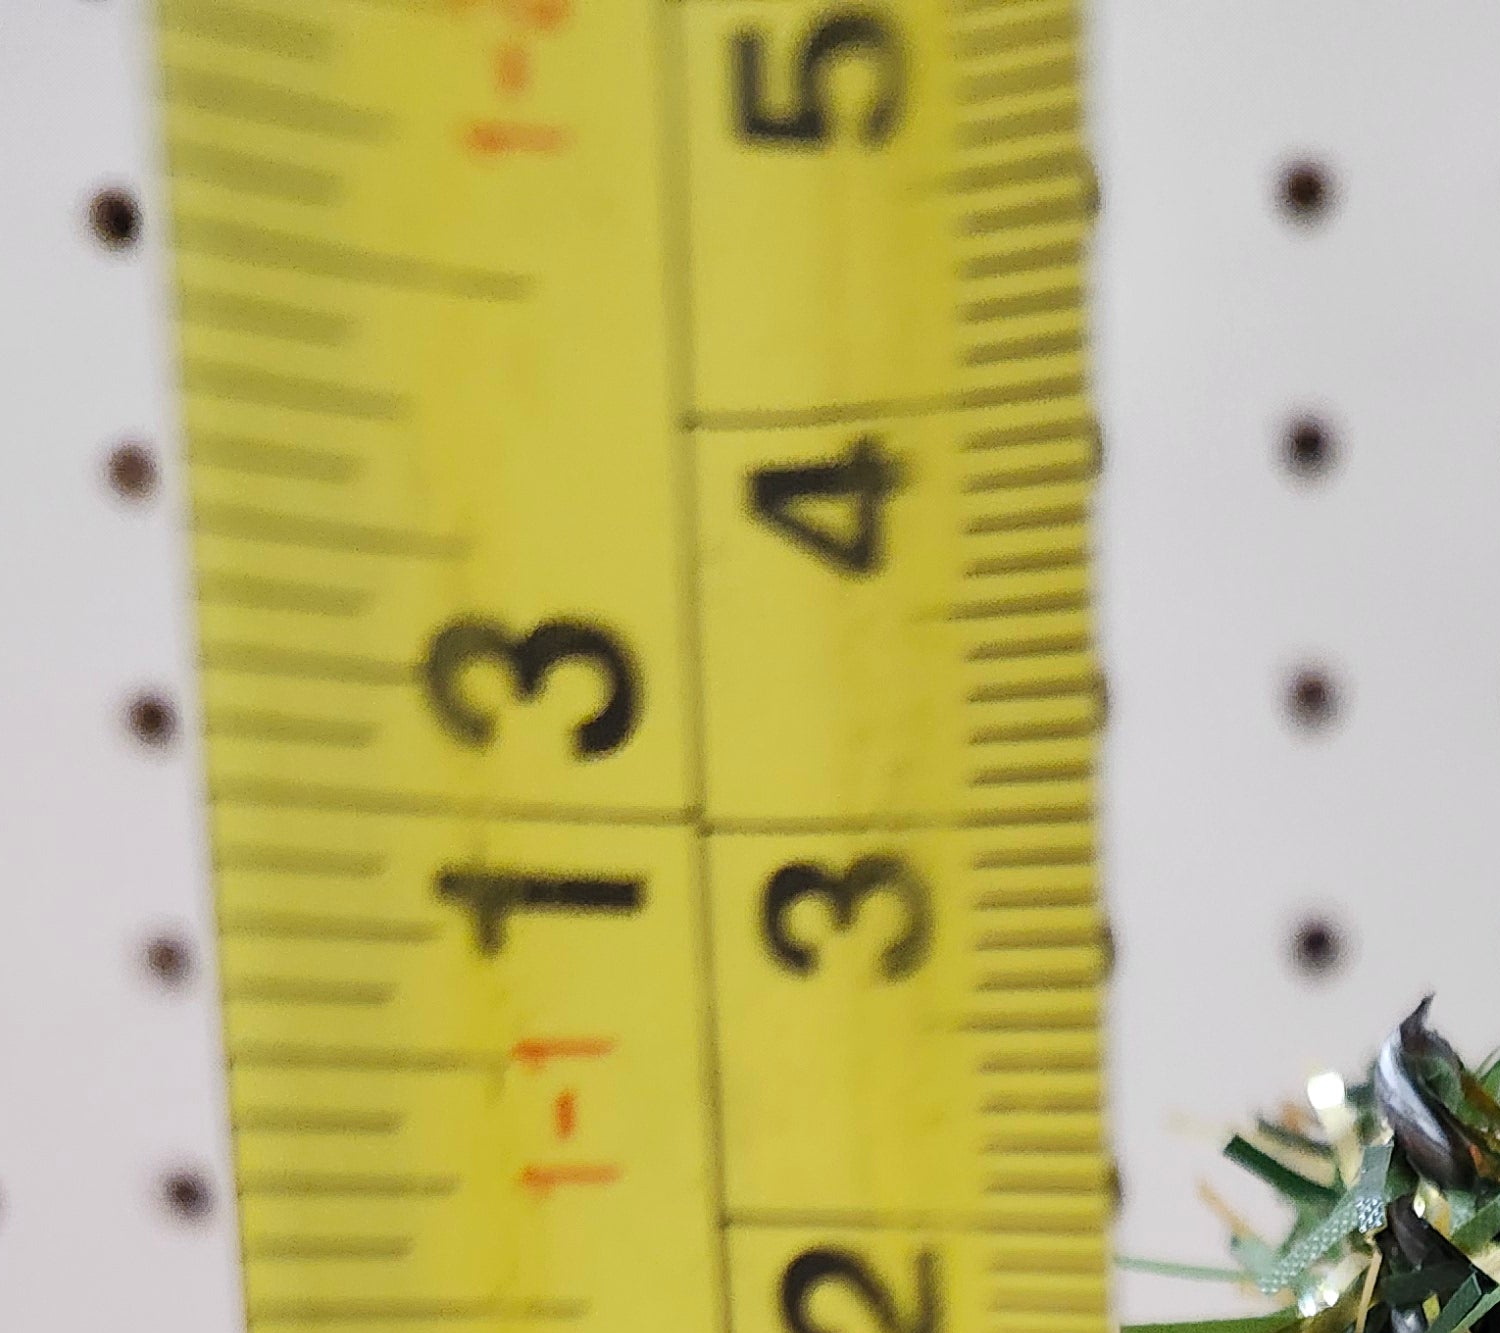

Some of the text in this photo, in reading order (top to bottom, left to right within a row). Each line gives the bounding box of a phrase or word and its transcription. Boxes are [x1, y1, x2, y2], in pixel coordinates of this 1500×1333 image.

[450, 0, 572, 155] 1-
[730, 12, 912, 152] 5
[744, 434, 912, 580] 4
[415, 614, 646, 956] 13
[760, 853, 935, 982] 3
[510, 1036, 624, 1196] 1-1
